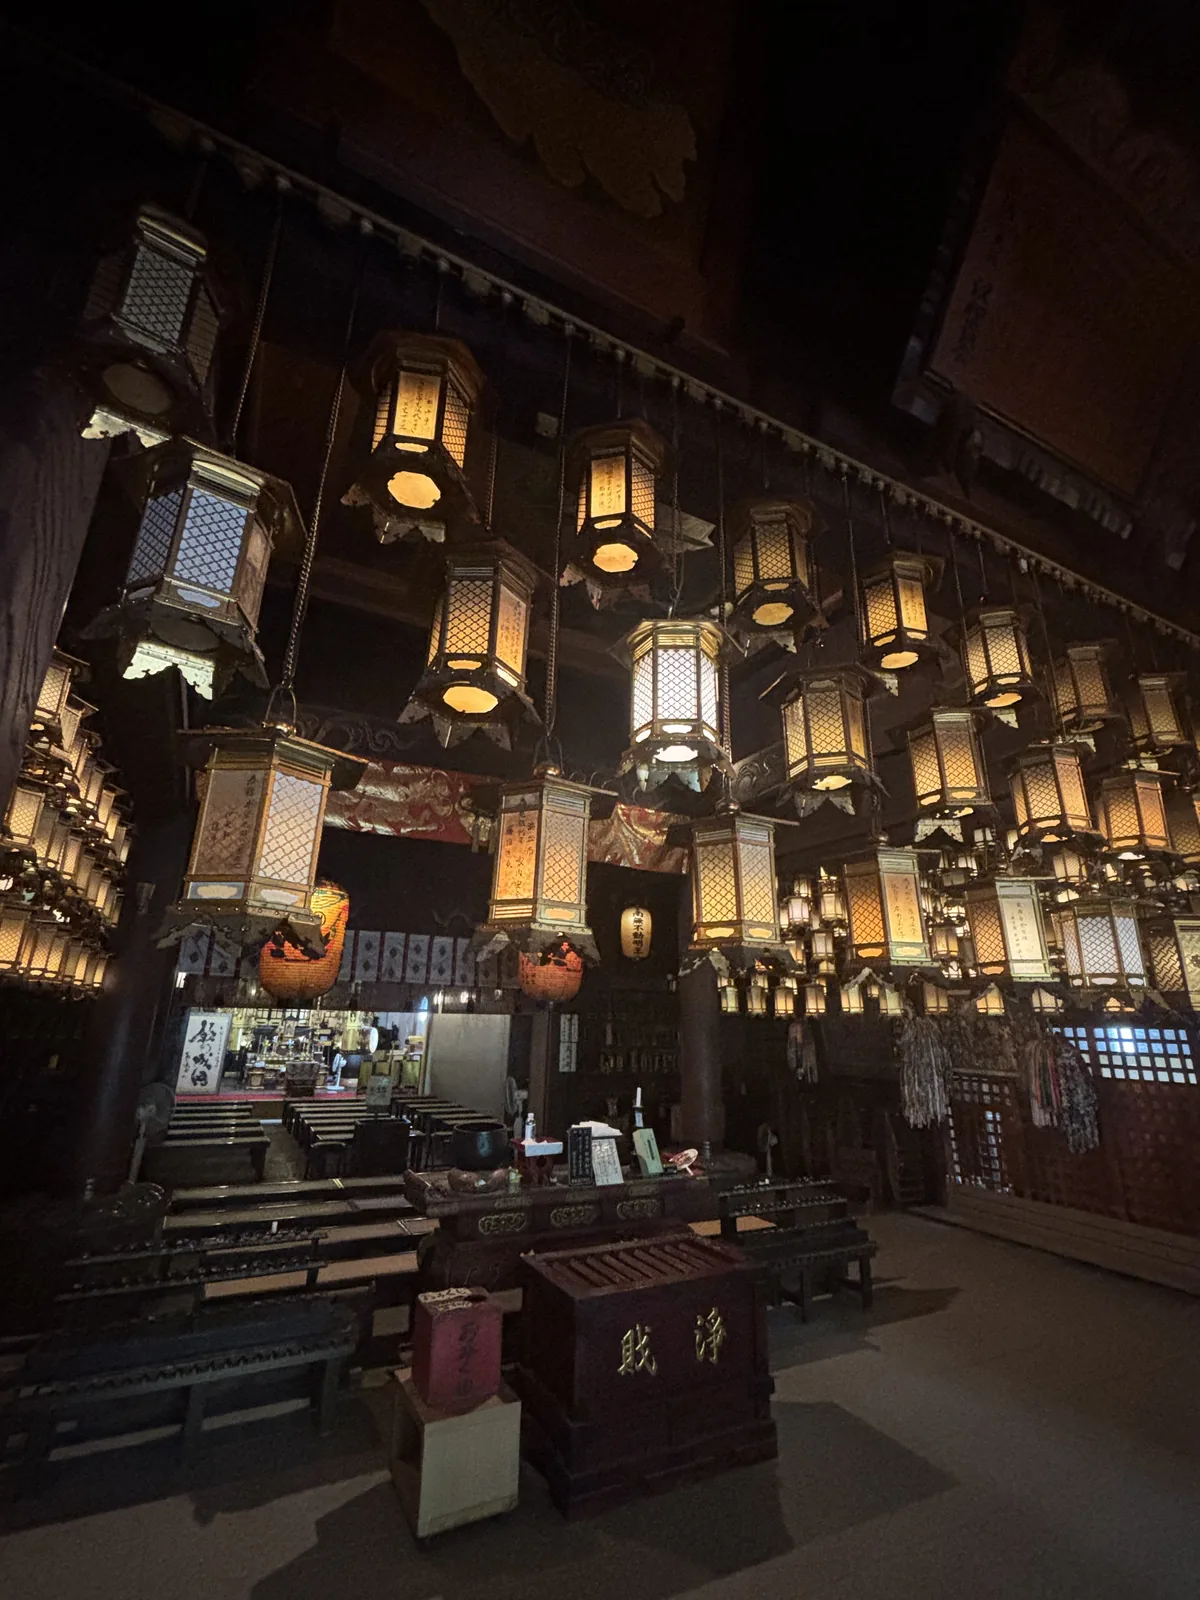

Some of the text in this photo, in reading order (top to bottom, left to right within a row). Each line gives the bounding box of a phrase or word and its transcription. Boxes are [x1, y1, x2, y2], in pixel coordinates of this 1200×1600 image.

[632, 906, 644, 955] 南無不動明王
